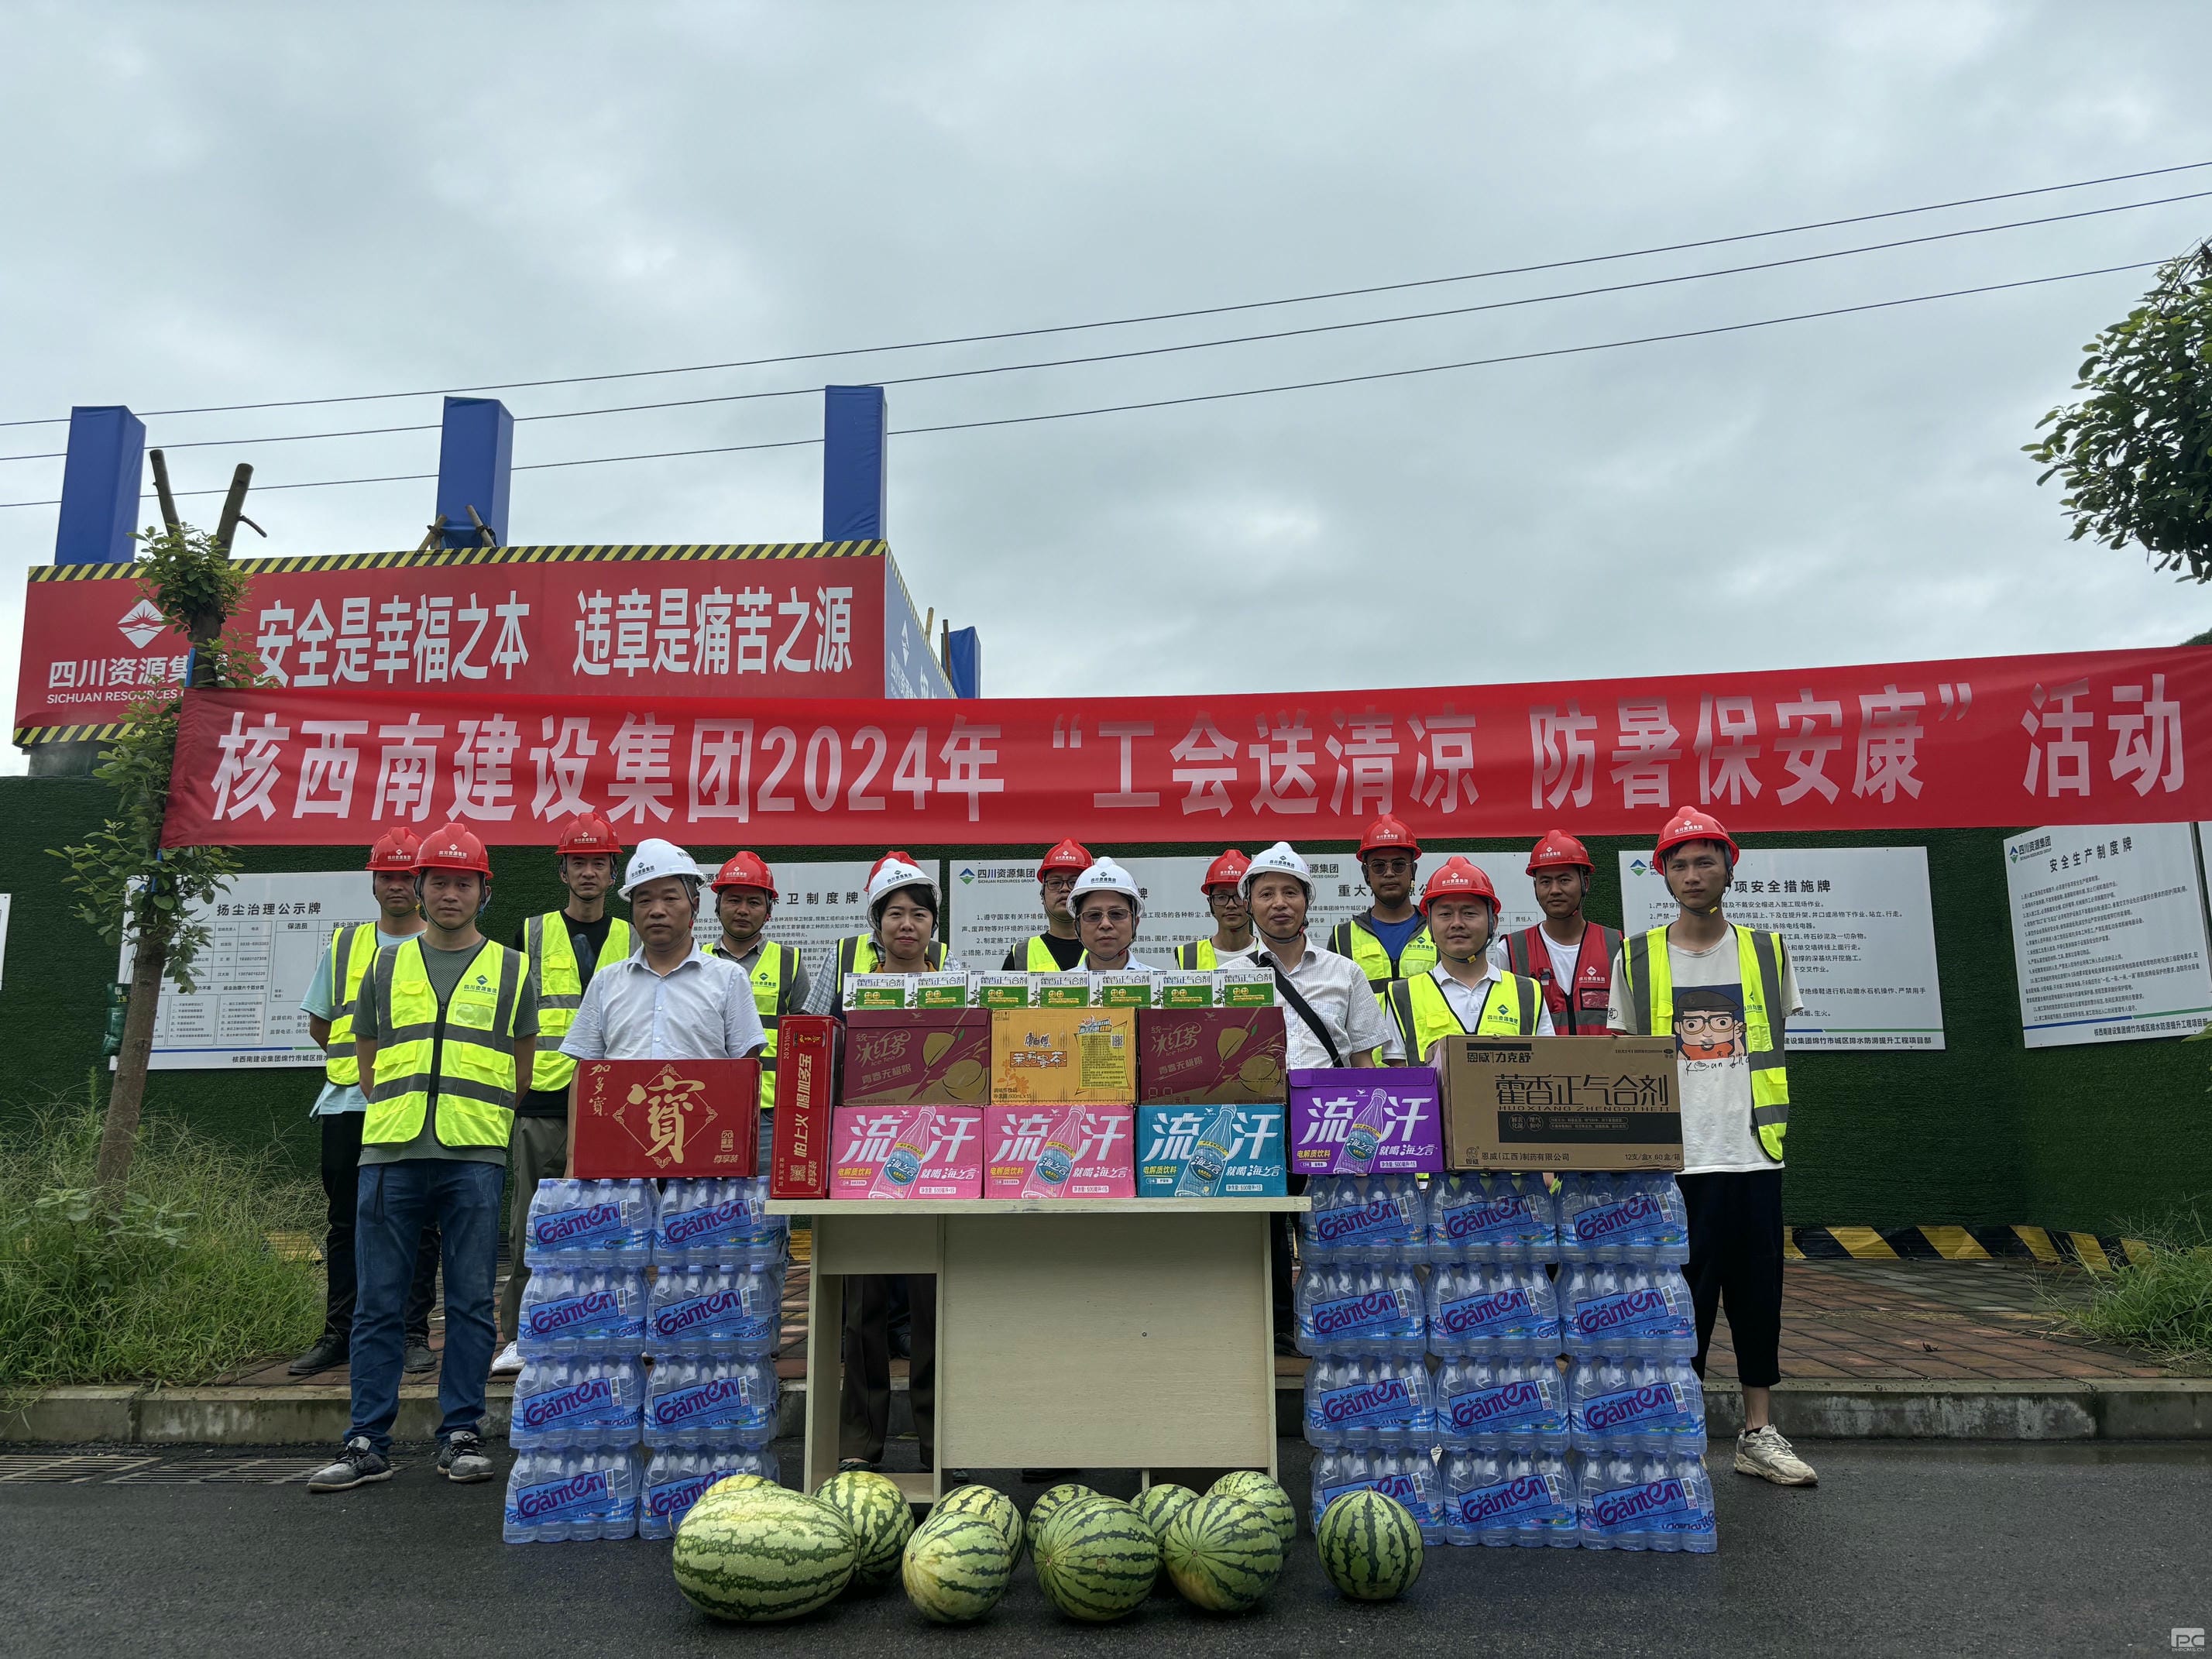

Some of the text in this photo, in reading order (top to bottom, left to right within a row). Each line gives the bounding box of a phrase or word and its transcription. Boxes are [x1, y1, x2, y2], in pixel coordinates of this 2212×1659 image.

[256, 590, 530, 687] 安全是幸福之本
[572, 586, 853, 676] 违章是痛苦之源
[49, 654, 228, 689] 四川资源集
[46, 692, 102, 704] SICHUAN
[211, 712, 1005, 824] 核西南建设集团2024年
[2020, 674, 2186, 799] 活动
[2018, 836, 2052, 855] 四川资源集团
[2049, 836, 2132, 873] 安全生产制度牌
[977, 868, 1036, 878] 四川资源集团
[1307, 864, 1339, 874] 源集团
[1734, 879, 1832, 893] 项安全措施牌
[217, 902, 321, 916] 扬尘治理公示牌
[1011, 1050, 1066, 1069] 茉莉蜜茶
[1467, 1052, 1530, 1063] 恩威 力克舒
[1495, 1073, 1669, 1106] 藿香正气合剂
[793, 1113, 809, 1157] 怕上火
